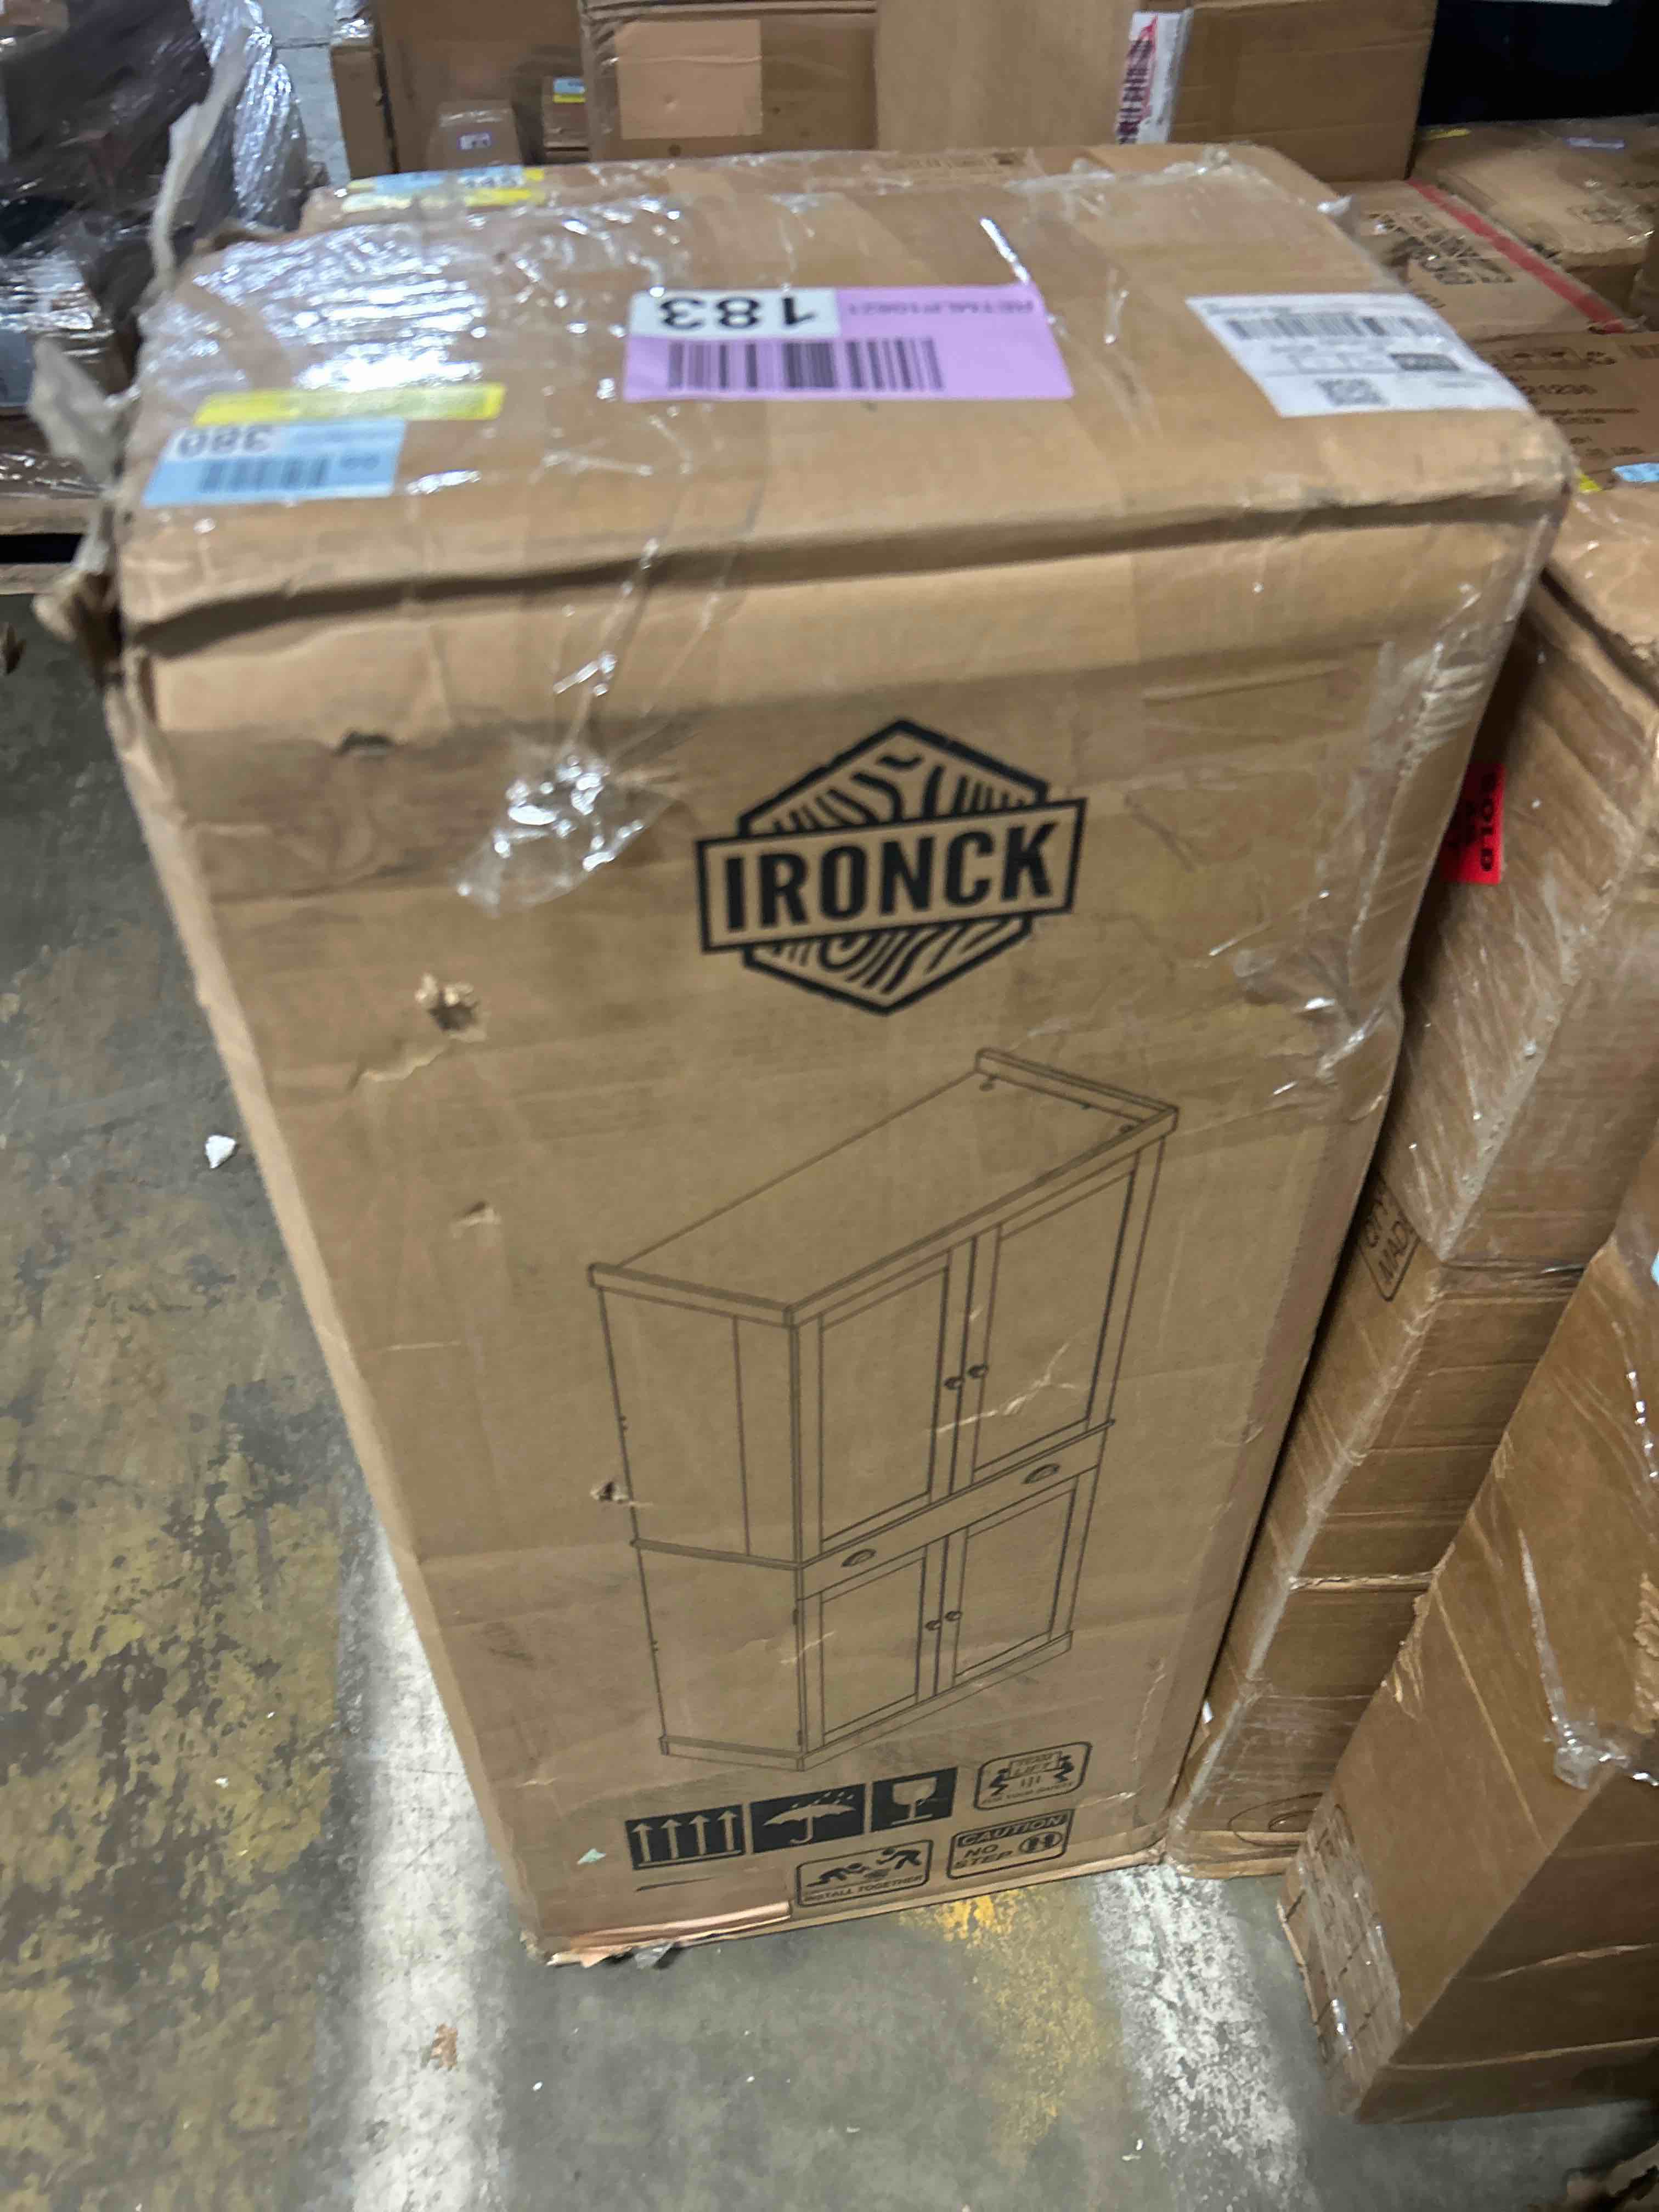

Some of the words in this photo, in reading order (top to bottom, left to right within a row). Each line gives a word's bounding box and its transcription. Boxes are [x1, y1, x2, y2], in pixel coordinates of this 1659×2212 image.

[660, 296, 819, 330] 183
[724, 821, 1058, 933] IRONCK
[962, 1814, 1065, 1846] CAUTION
[953, 1850, 1013, 1869] STEP
[964, 1844, 998, 1858] NO
